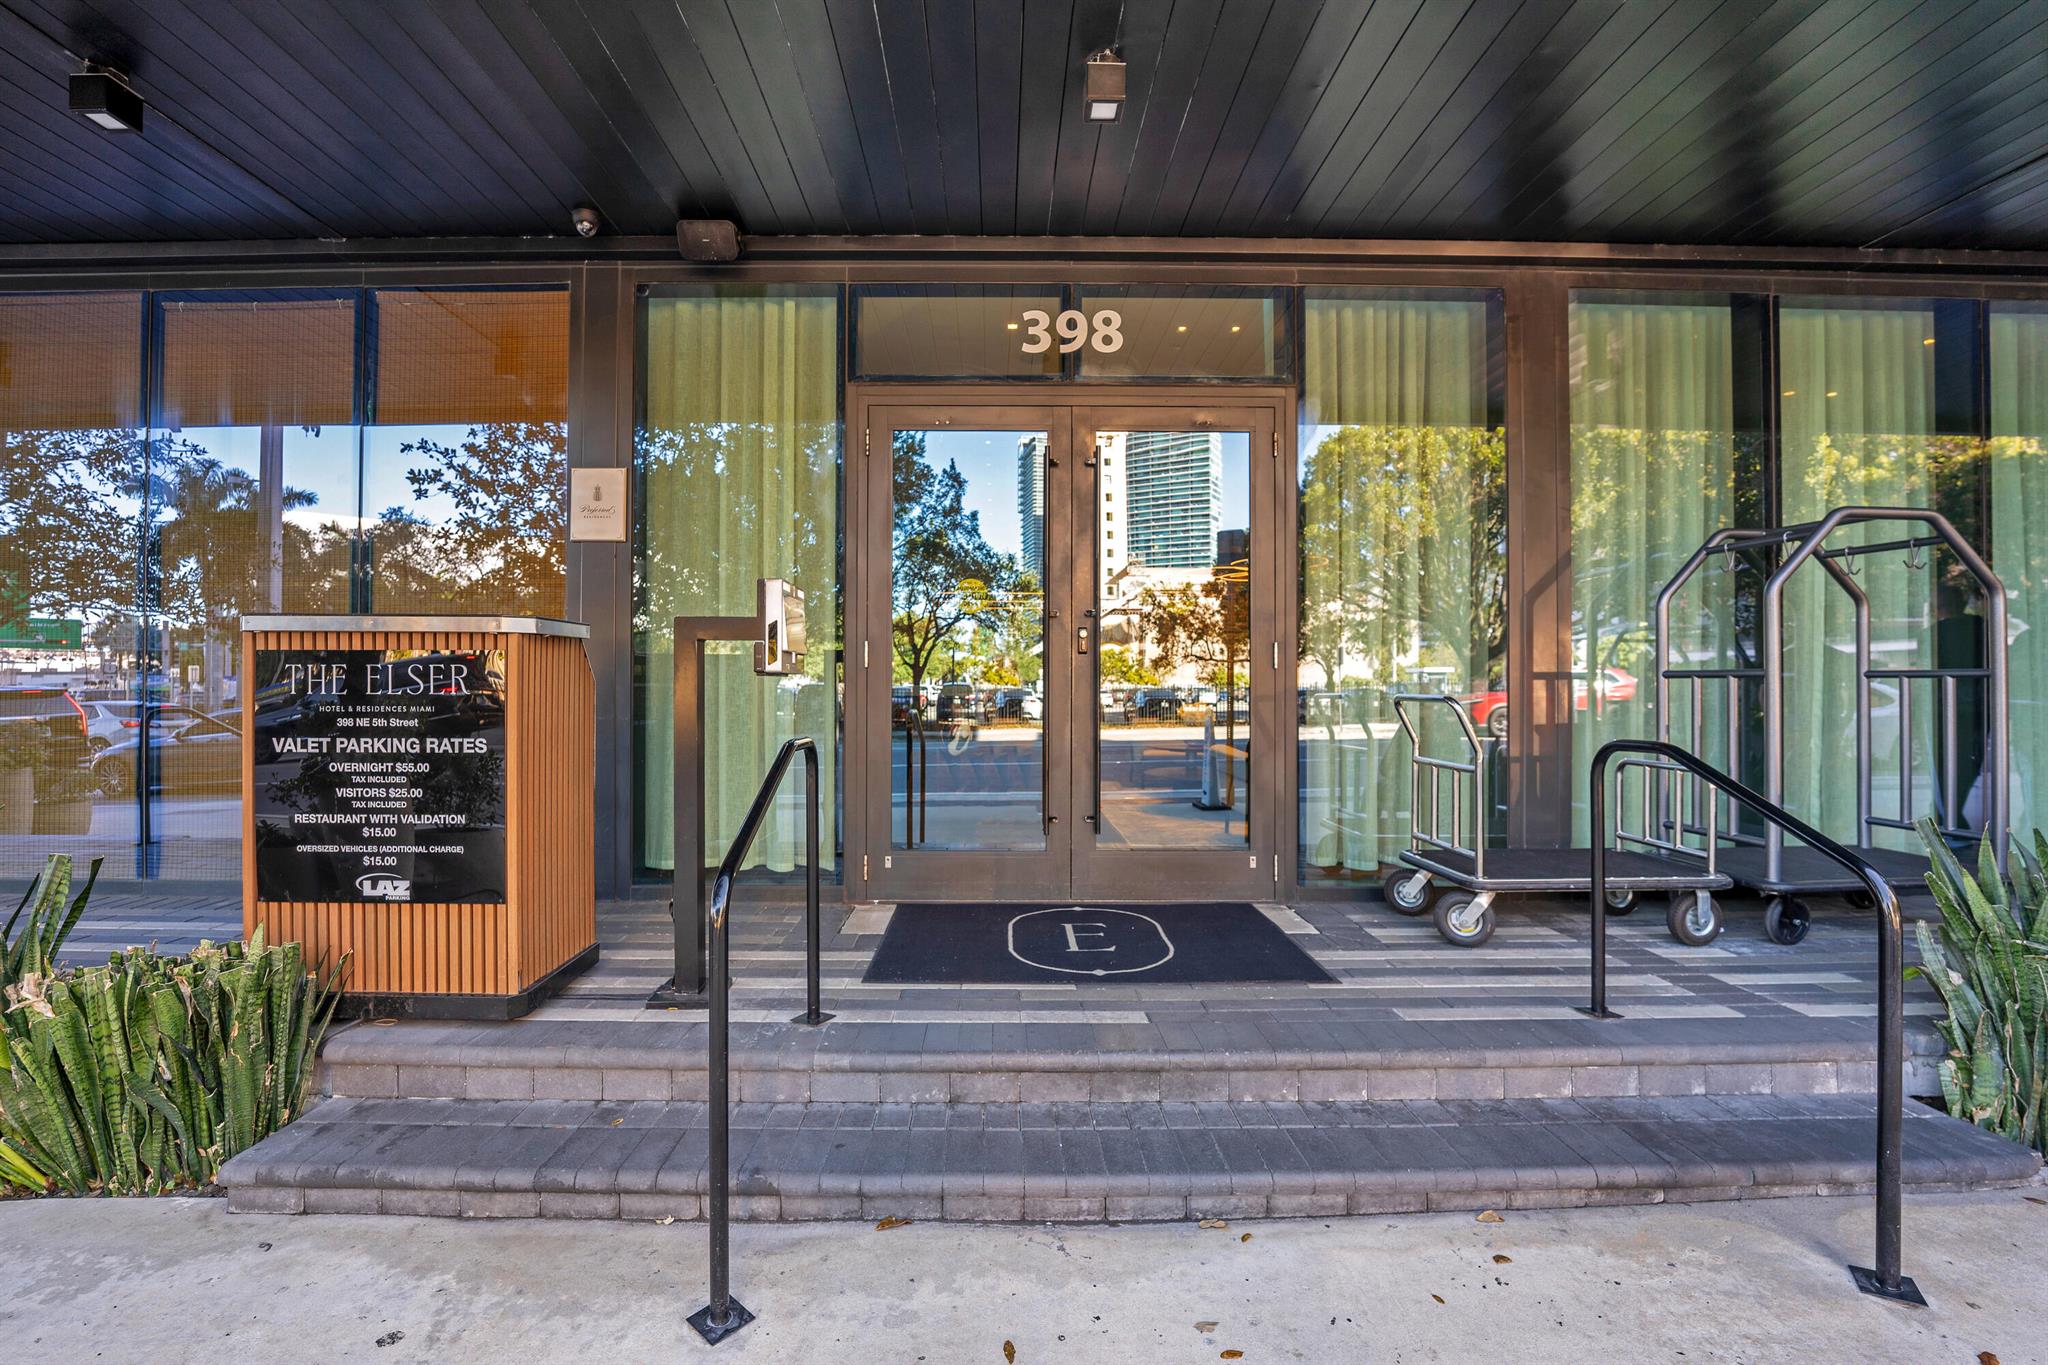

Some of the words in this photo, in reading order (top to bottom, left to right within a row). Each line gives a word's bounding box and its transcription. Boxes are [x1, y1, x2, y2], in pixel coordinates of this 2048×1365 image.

[1021, 309, 1124, 353] 398
[284, 664, 347, 695] THE
[365, 664, 470, 695] ELSER
[337, 718, 354, 727] 398
[356, 718, 370, 727] NE
[372, 718, 387, 727] 5th
[390, 718, 418, 727] Street
[272, 737, 330, 753] VALET
[336, 737, 420, 753] PARKING
[426, 737, 488, 753] RATES
[329, 763, 393, 772] OVERNIGHT
[395, 762, 429, 772] $55.00
[336, 788, 386, 797] VISITORS
[389, 788, 422, 798] $25.00
[294, 814, 367, 824] RESTAURANT
[369, 814, 398, 824] WITH
[401, 814, 465, 824] VALIDATION
[362, 828, 396, 837] $15.00
[380, 845, 428, 853] (ADDITIONAL
[429, 845, 464, 853] CHARGE)
[363, 856, 397, 866] $15.00
[363, 880, 410, 896] LAZ
[1060, 923, 1117, 952] E
